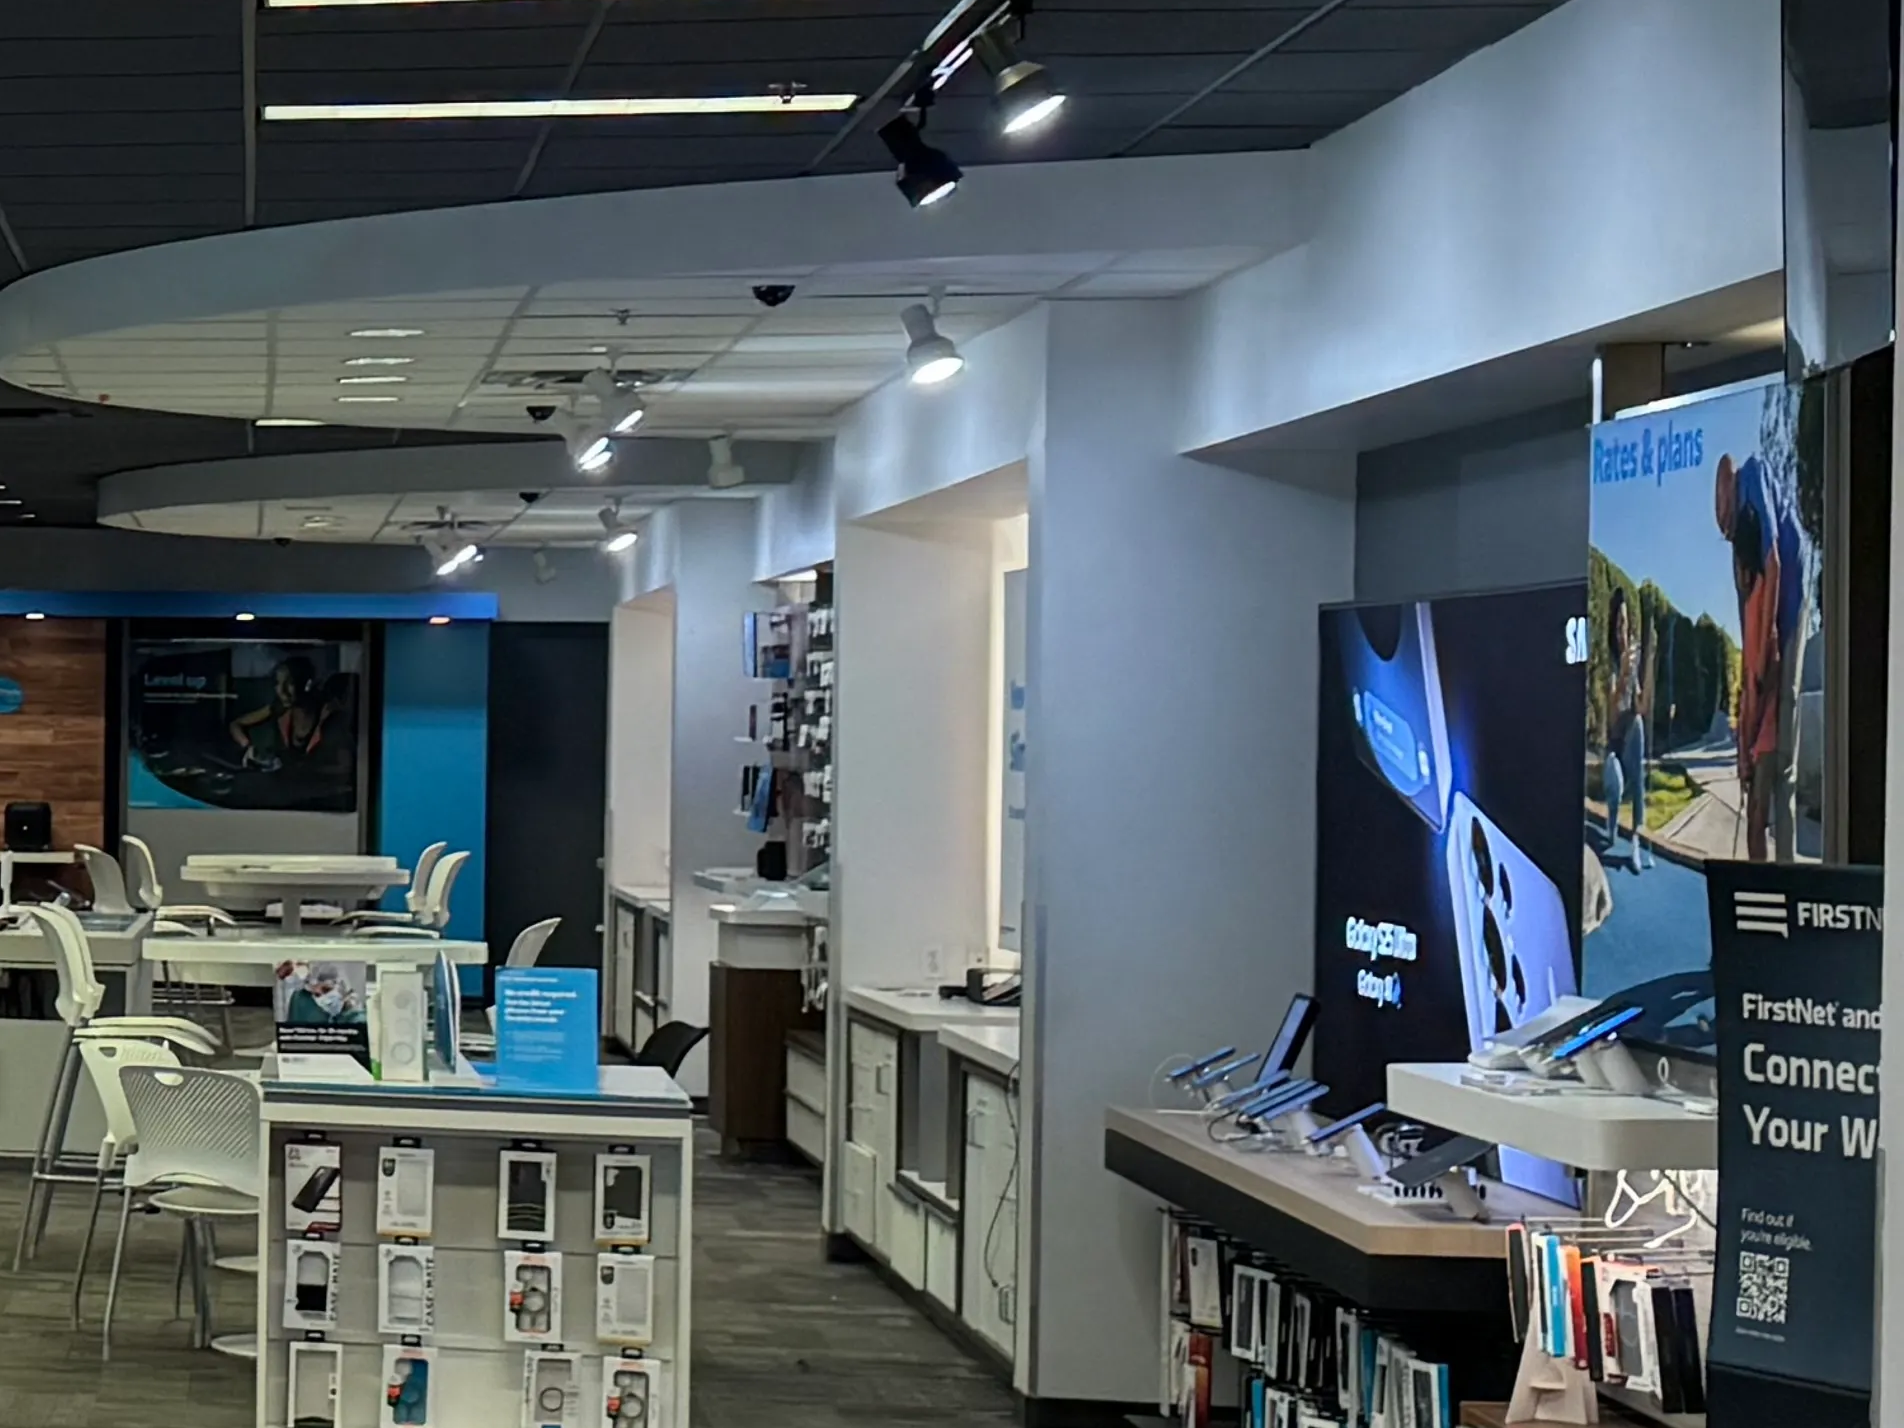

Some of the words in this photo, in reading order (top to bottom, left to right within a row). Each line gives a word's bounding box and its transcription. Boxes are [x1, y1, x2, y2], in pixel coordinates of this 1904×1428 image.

[1594, 438, 1638, 484] Rates
[1642, 428, 1653, 476] &
[1657, 420, 1703, 487] plans
[1744, 1043, 1880, 1094] Connec
[1743, 1104, 1829, 1152] Your
[1841, 1115, 1877, 1160] W
[1741, 1228, 1772, 1245] you're
[1742, 1208, 1764, 1224] Find
[1766, 1213, 1784, 1228] out
[1786, 1214, 1794, 1228] if
